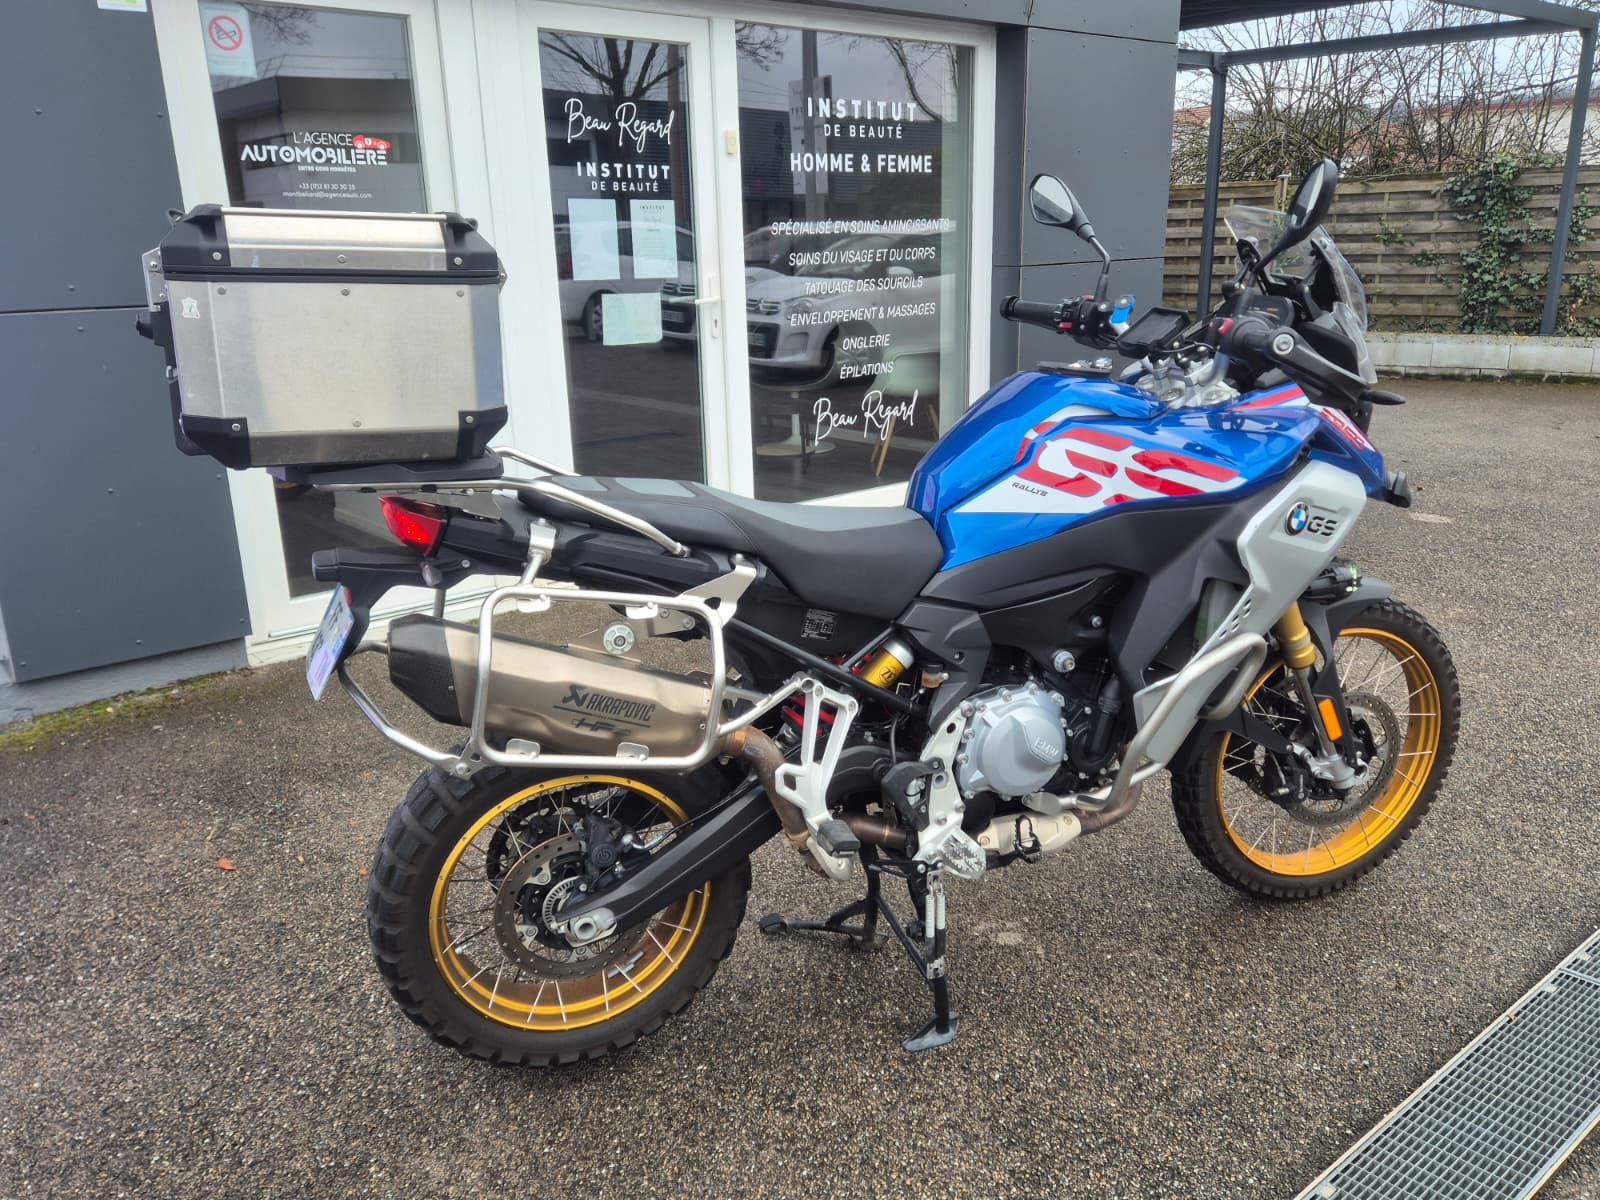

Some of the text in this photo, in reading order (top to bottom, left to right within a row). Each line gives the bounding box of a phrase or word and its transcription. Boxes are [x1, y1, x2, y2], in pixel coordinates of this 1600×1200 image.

[807, 97, 917, 122] INSTITUT
[564, 97, 675, 153] Beau Regard
[824, 123, 903, 139] DE BEAUTÉ
[293, 131, 353, 146] L'AGENCE
[576, 161, 670, 179] INSTITUT
[790, 152, 933, 173] HOMME & FEMME
[591, 180, 659, 192] DE BEAUTÉ
[770, 217, 950, 236] SPÉCIALISÉ EN SOINS AMINCISSANTS
[789, 247, 936, 266] SOINS DU VISAGE ET DU CORPS
[804, 275, 924, 295] TATOUAGE DES SOURCILS
[790, 302, 936, 327] ENVELOPPEMENT & MASSAGES
[842, 333, 891, 351] ONGLERIE
[839, 361, 895, 379] ÉPILATIONS
[813, 388, 919, 446] Beau Regard
[1307, 516, 1338, 537] GS
